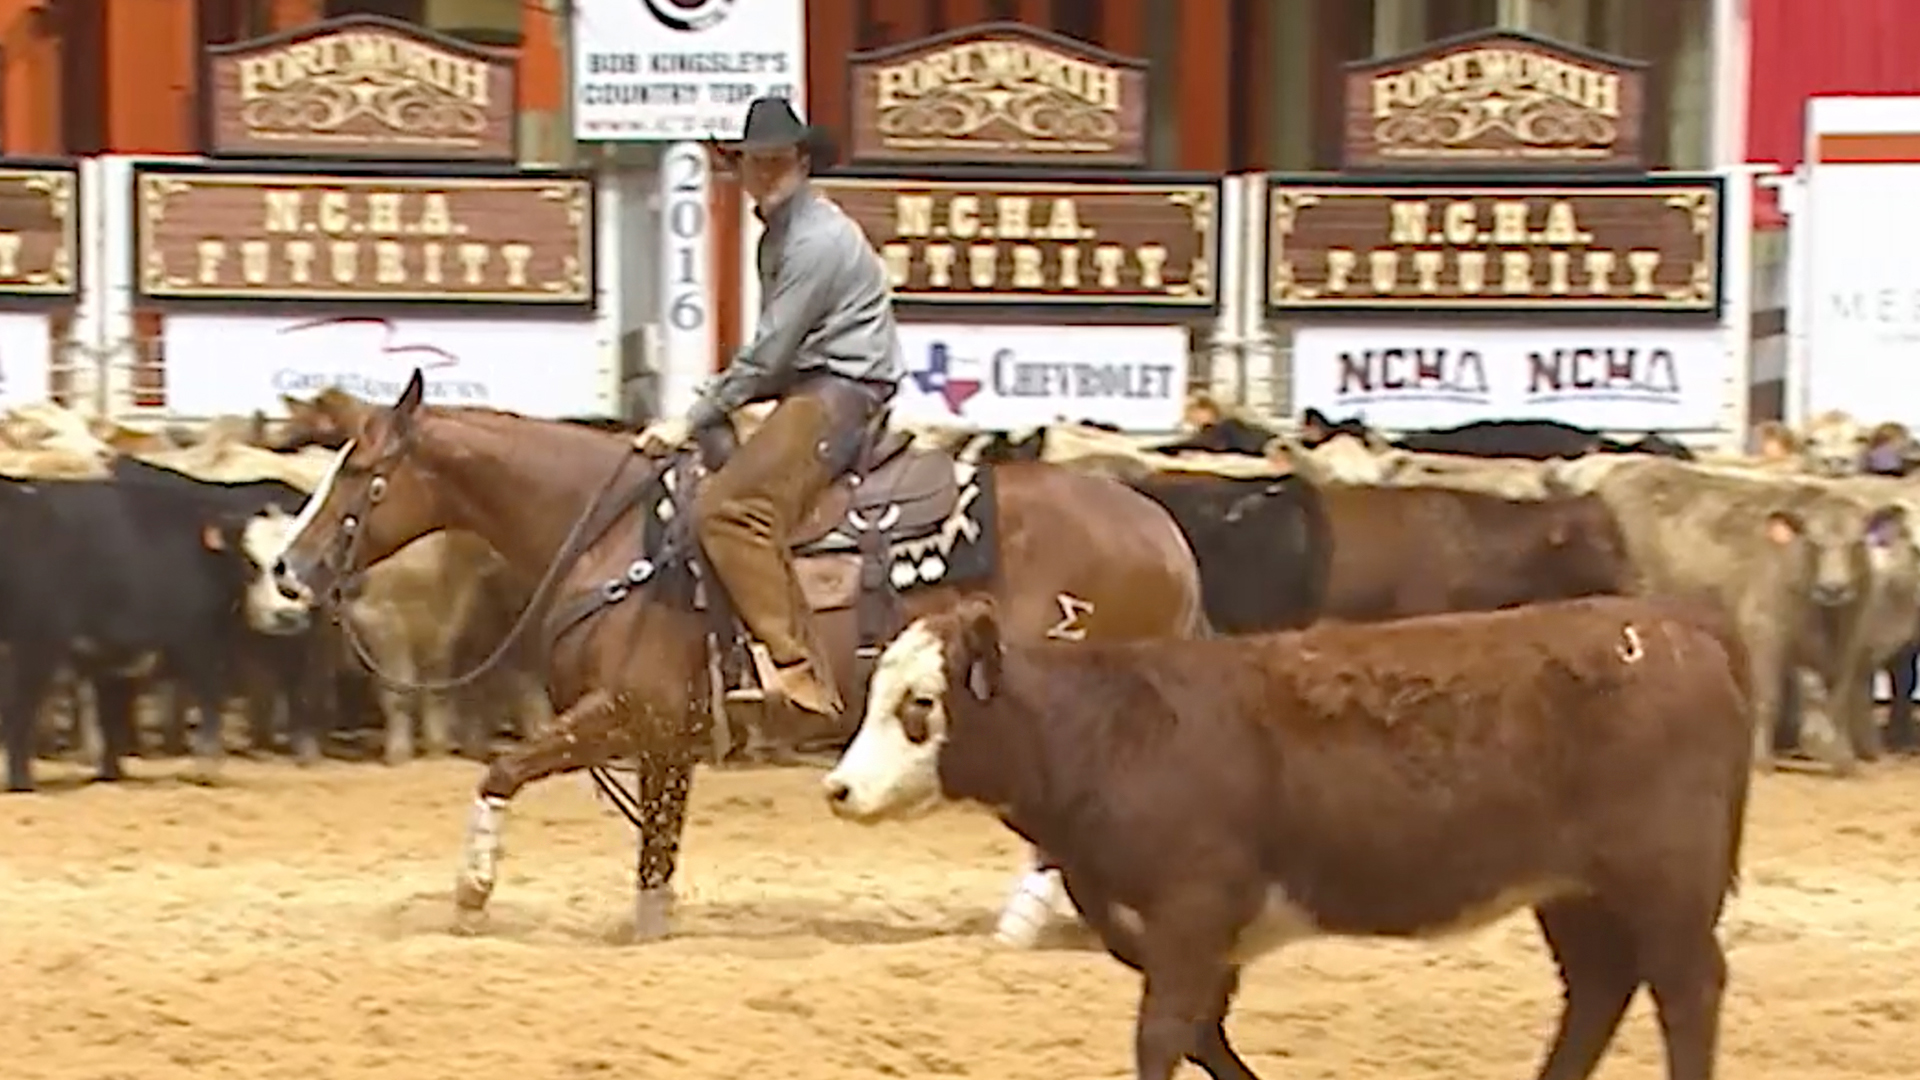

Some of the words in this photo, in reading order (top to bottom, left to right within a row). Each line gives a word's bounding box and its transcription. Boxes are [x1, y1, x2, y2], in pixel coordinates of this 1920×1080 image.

[341, 33, 489, 107] WORTH
[586, 52, 641, 73] BOB
[979, 41, 1122, 111] WORTH
[1476, 49, 1621, 117] WORTH
[580, 82, 697, 105] COUNTRY
[708, 82, 757, 104] TOP
[263, 190, 468, 235] N.C.H.A.
[896, 194, 1096, 239] N.C.H.A.
[1390, 202, 1595, 245] N.C.H.A.
[198, 241, 534, 285] FUTURITY
[668, 153, 706, 330] 2016
[882, 243, 1168, 289] UTURITY
[1327, 250, 1661, 296] FUTURITY
[1336, 348, 1490, 394] NCHA
[1527, 348, 1681, 394] NCHA
